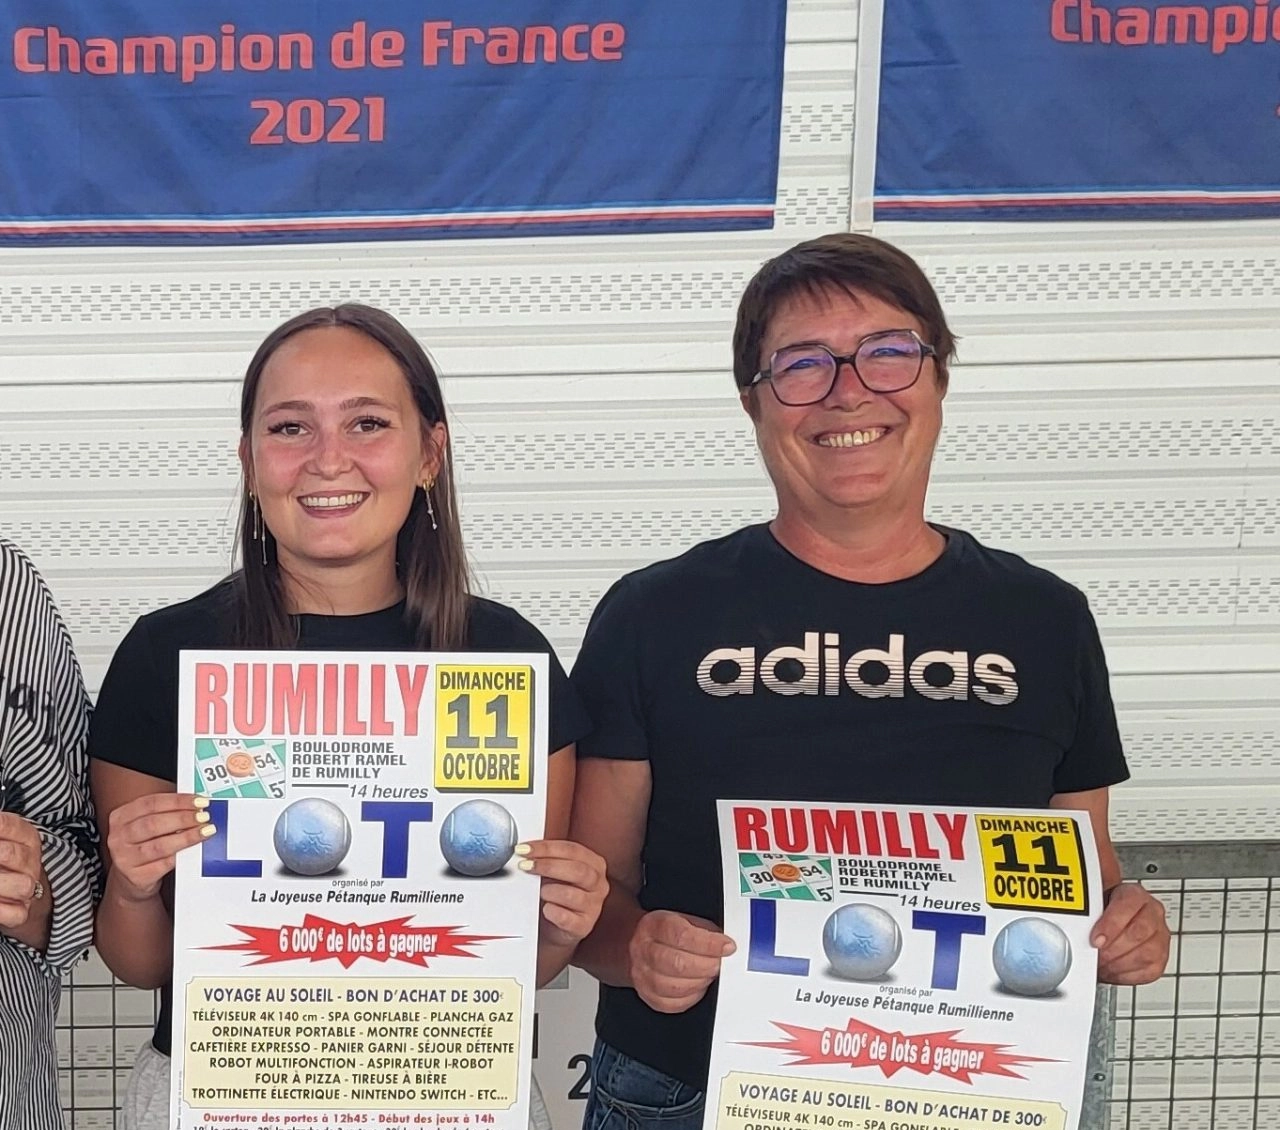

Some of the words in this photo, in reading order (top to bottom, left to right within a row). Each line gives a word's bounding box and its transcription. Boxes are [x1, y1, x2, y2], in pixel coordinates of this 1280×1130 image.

[1051, 0, 1280, 54] Champi
[13, 23, 314, 83] Champion
[329, 21, 406, 70] de
[422, 21, 625, 67] France
[249, 96, 385, 145] 2021
[696, 632, 1020, 706] adidas
[440, 671, 525, 690] DIMANCHE
[194, 662, 428, 736] RUMILLY
[446, 694, 517, 748] 11
[293, 741, 393, 753] BOULODROME
[255, 753, 276, 769] 54
[292, 754, 350, 765] ROBERT
[356, 754, 406, 765] RAMEL
[443, 753, 520, 780] OCTOBRE
[204, 765, 226, 781] 30
[292, 767, 310, 777] DE
[316, 767, 380, 778] RUMILLY
[350, 784, 367, 797] 14
[372, 785, 428, 798] heures
[980, 819, 1069, 832] DIMANCHE
[733, 807, 968, 860] RUMILLY
[992, 833, 1069, 875] 11
[838, 858, 941, 871] BOULODROME
[839, 867, 897, 878] ROBERT
[903, 871, 955, 881] RAMEL
[839, 877, 857, 886] DE
[864, 878, 929, 890] RUMILLY
[994, 874, 1074, 900] OCTOBRE
[251, 890, 266, 902] La
[270, 890, 322, 904] Joyeuse
[327, 890, 386, 905] Pétanque
[390, 890, 464, 902] Rumillienne
[900, 895, 917, 906] 14
[923, 896, 980, 910] heures
[279, 931, 288, 952] 6
[326, 932, 343, 952] de
[347, 932, 373, 952] lots
[377, 932, 385, 952] à
[389, 933, 437, 957] gagner
[204, 988, 260, 1002] VOYAGE
[266, 988, 284, 1001] AU
[290, 988, 333, 1002] SOLEIL
[346, 989, 377, 1002] BON
[451, 990, 467, 1002] DE
[796, 988, 811, 1001] La
[815, 991, 868, 1007] Joyeuse
[873, 996, 933, 1015] Pétanque
[938, 1002, 1013, 1021] Rumillienne
[192, 1008, 255, 1021] TÉLÉVISEUR
[260, 1011, 274, 1020] 4K
[279, 1011, 298, 1021] 140
[328, 1011, 349, 1021] SPA
[354, 1012, 419, 1021] GONFLABLE
[431, 1012, 484, 1021] PLANCHA
[489, 1012, 513, 1021] GAZ
[212, 1026, 290, 1037] ORDINATEUR
[296, 1027, 355, 1036] PORTABLE
[367, 1027, 418, 1037] MONTRE
[423, 1027, 492, 1037] CONNECTÉE
[190, 1042, 246, 1052] CAFETIÈRE
[251, 1042, 310, 1052] EXPRESSO
[321, 1042, 363, 1052] PANIER
[368, 1042, 406, 1052] GARNI
[418, 1040, 461, 1053] SÉJOUR
[466, 1039, 513, 1052] DÉTENTE
[210, 1057, 251, 1067] ROBOT
[256, 1058, 355, 1068] MULTIFONCTION
[367, 1058, 439, 1068] ASPIRATEUR
[445, 1058, 493, 1068] I-ROBOT
[255, 1073, 287, 1083] FOUR
[292, 1071, 300, 1083] À
[305, 1074, 340, 1083] PIZZA
[352, 1073, 397, 1084] TIREUSE
[403, 1071, 410, 1083] À
[415, 1071, 446, 1084] BIÈRE
[567, 1053, 592, 1100] 2
[192, 1088, 266, 1098] TROTTINETTE
[271, 1089, 339, 1099] ÉLECTRIQUE
[351, 1089, 415, 1099] NINTENDO
[420, 1089, 465, 1099] SWITCH
